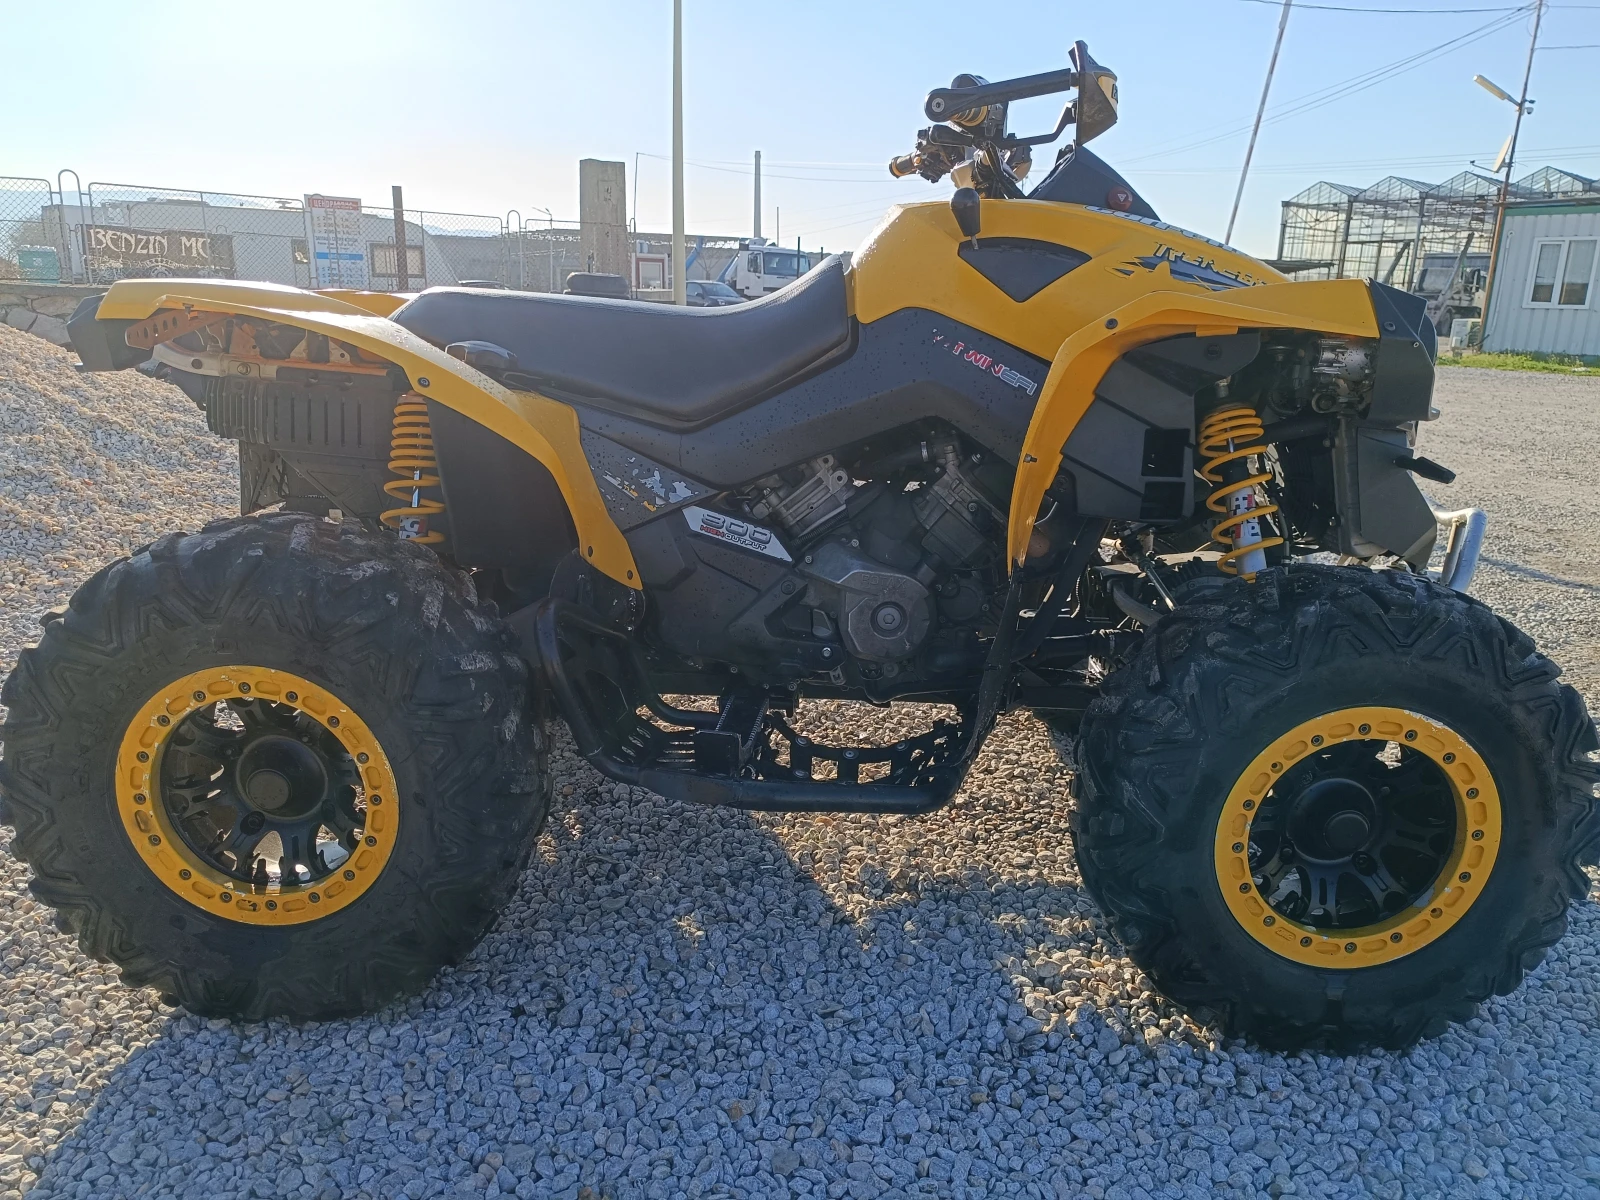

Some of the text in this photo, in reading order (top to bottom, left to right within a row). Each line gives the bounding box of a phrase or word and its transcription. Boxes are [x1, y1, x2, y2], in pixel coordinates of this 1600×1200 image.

[89, 228, 211, 258] BENZIN MC
[999, 366, 1038, 396] EFI
[700, 524, 767, 551] HIGH OUTPUT
[701, 512, 772, 545] 800
[861, 573, 907, 589] ROTAX
